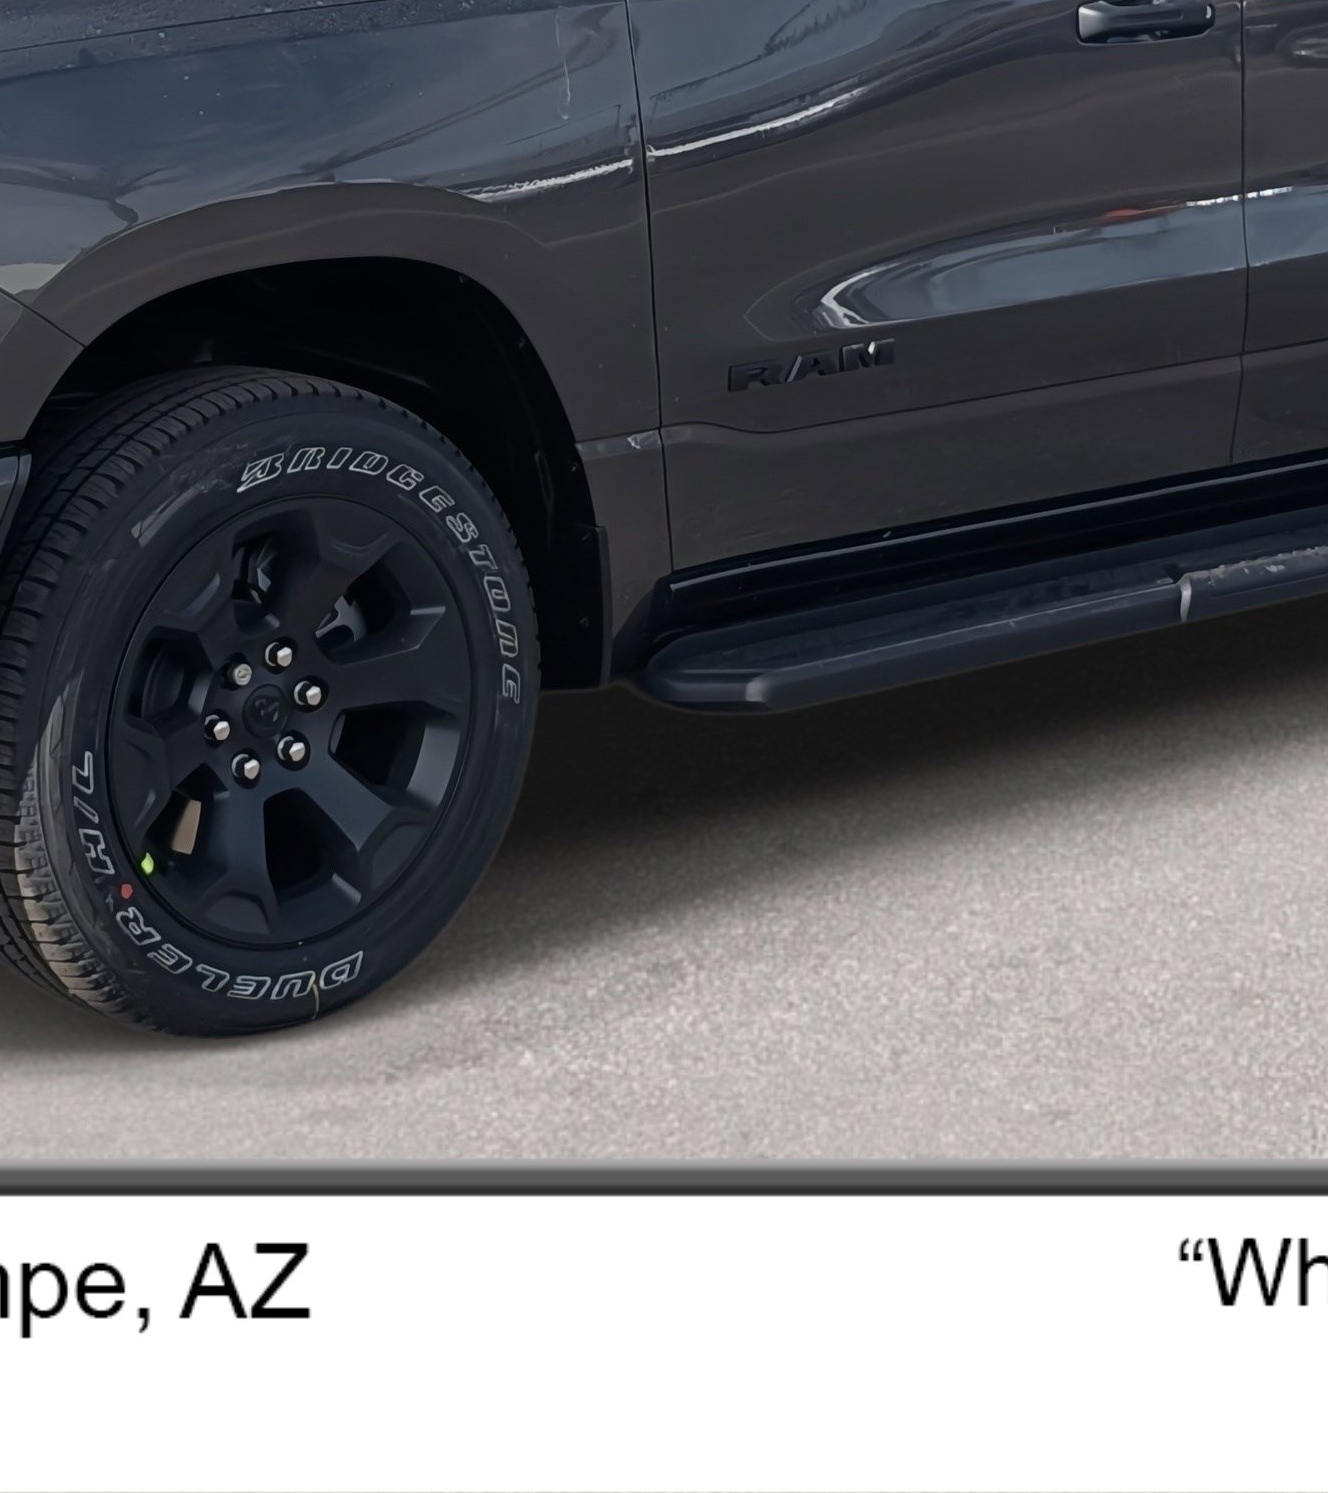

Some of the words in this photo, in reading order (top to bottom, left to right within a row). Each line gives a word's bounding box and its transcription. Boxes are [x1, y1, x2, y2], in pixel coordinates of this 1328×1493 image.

[728, 338, 895, 393] RAM
[236, 446, 521, 705] BRIDGESTONE
[116, 906, 363, 1001] DUELER
